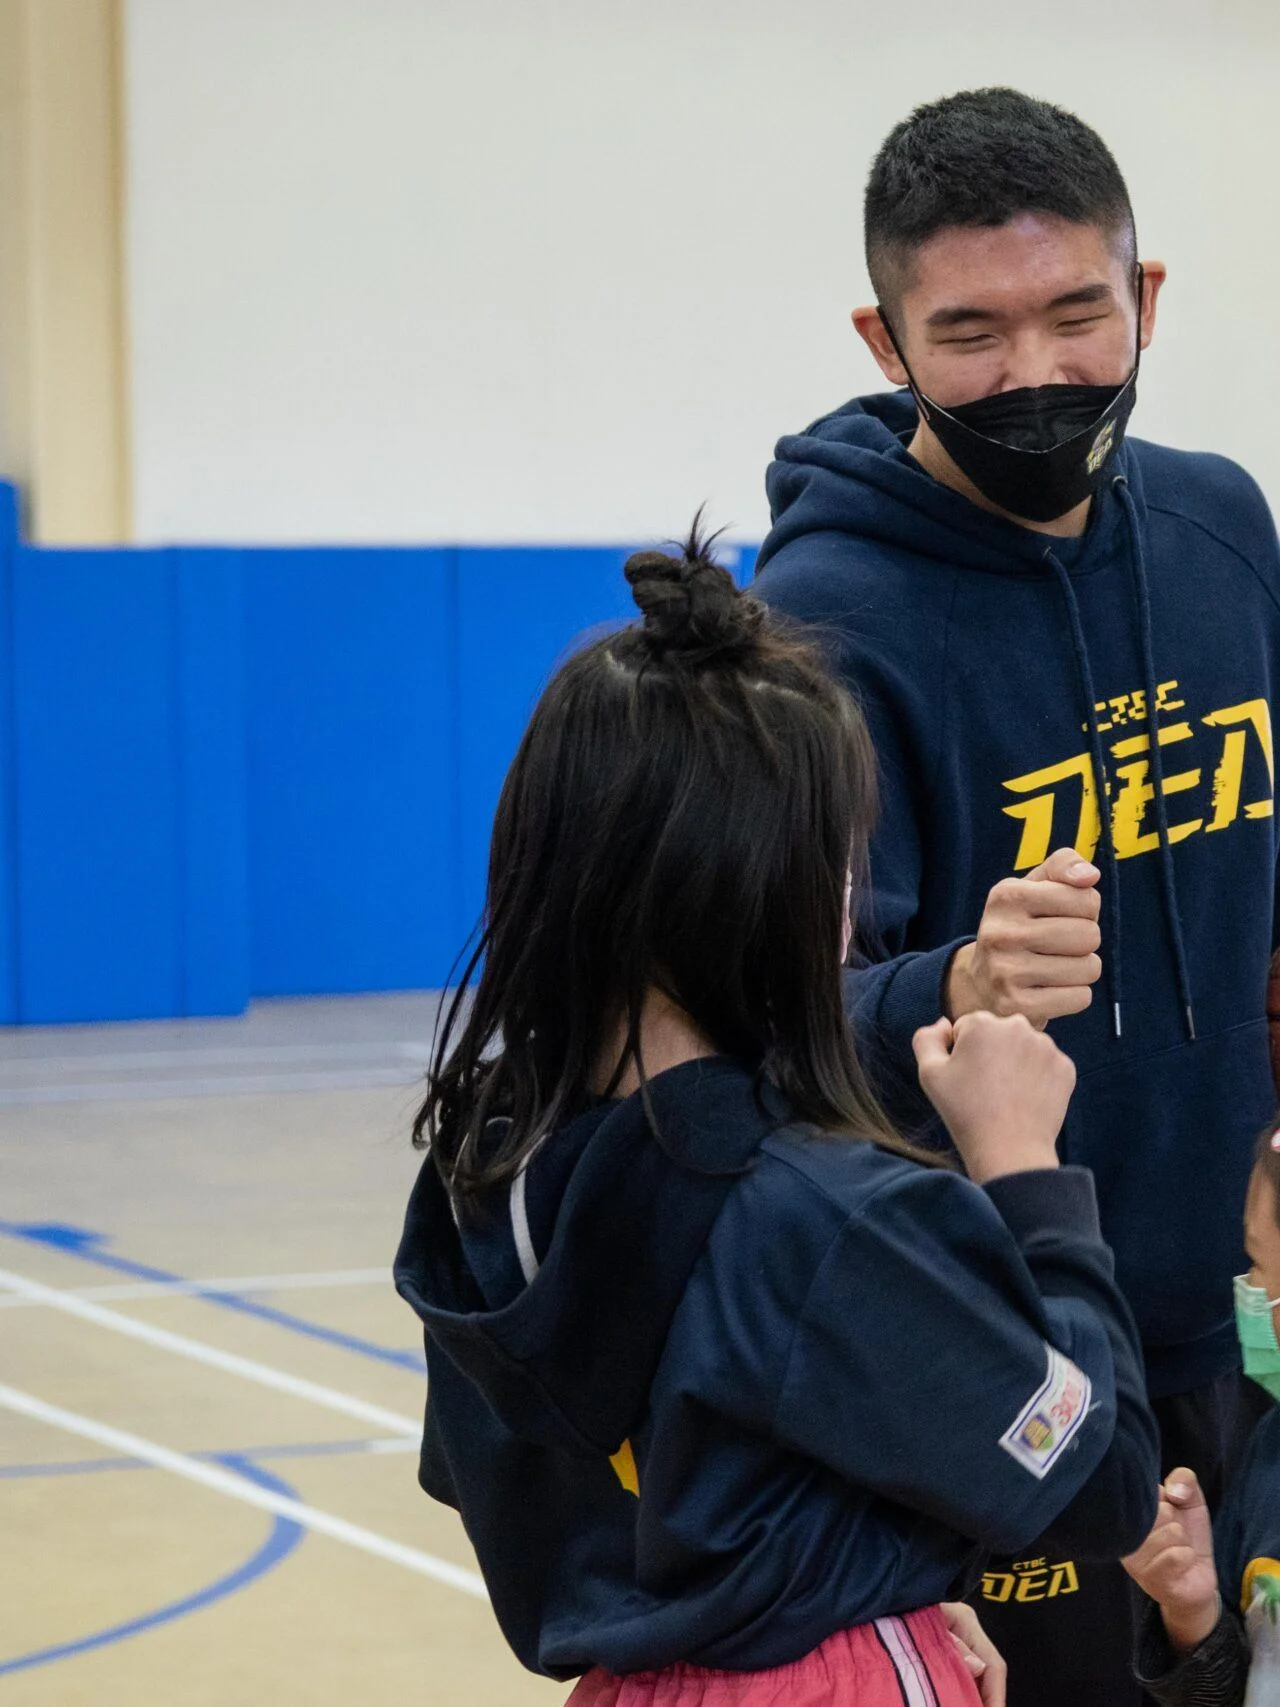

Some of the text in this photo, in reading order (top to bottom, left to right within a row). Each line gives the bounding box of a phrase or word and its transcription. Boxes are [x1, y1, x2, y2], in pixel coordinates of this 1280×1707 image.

[1001, 698, 1273, 871] DEA
[981, 1561, 1079, 1602] DEA
[1012, 1557, 1046, 1570] CTBC
